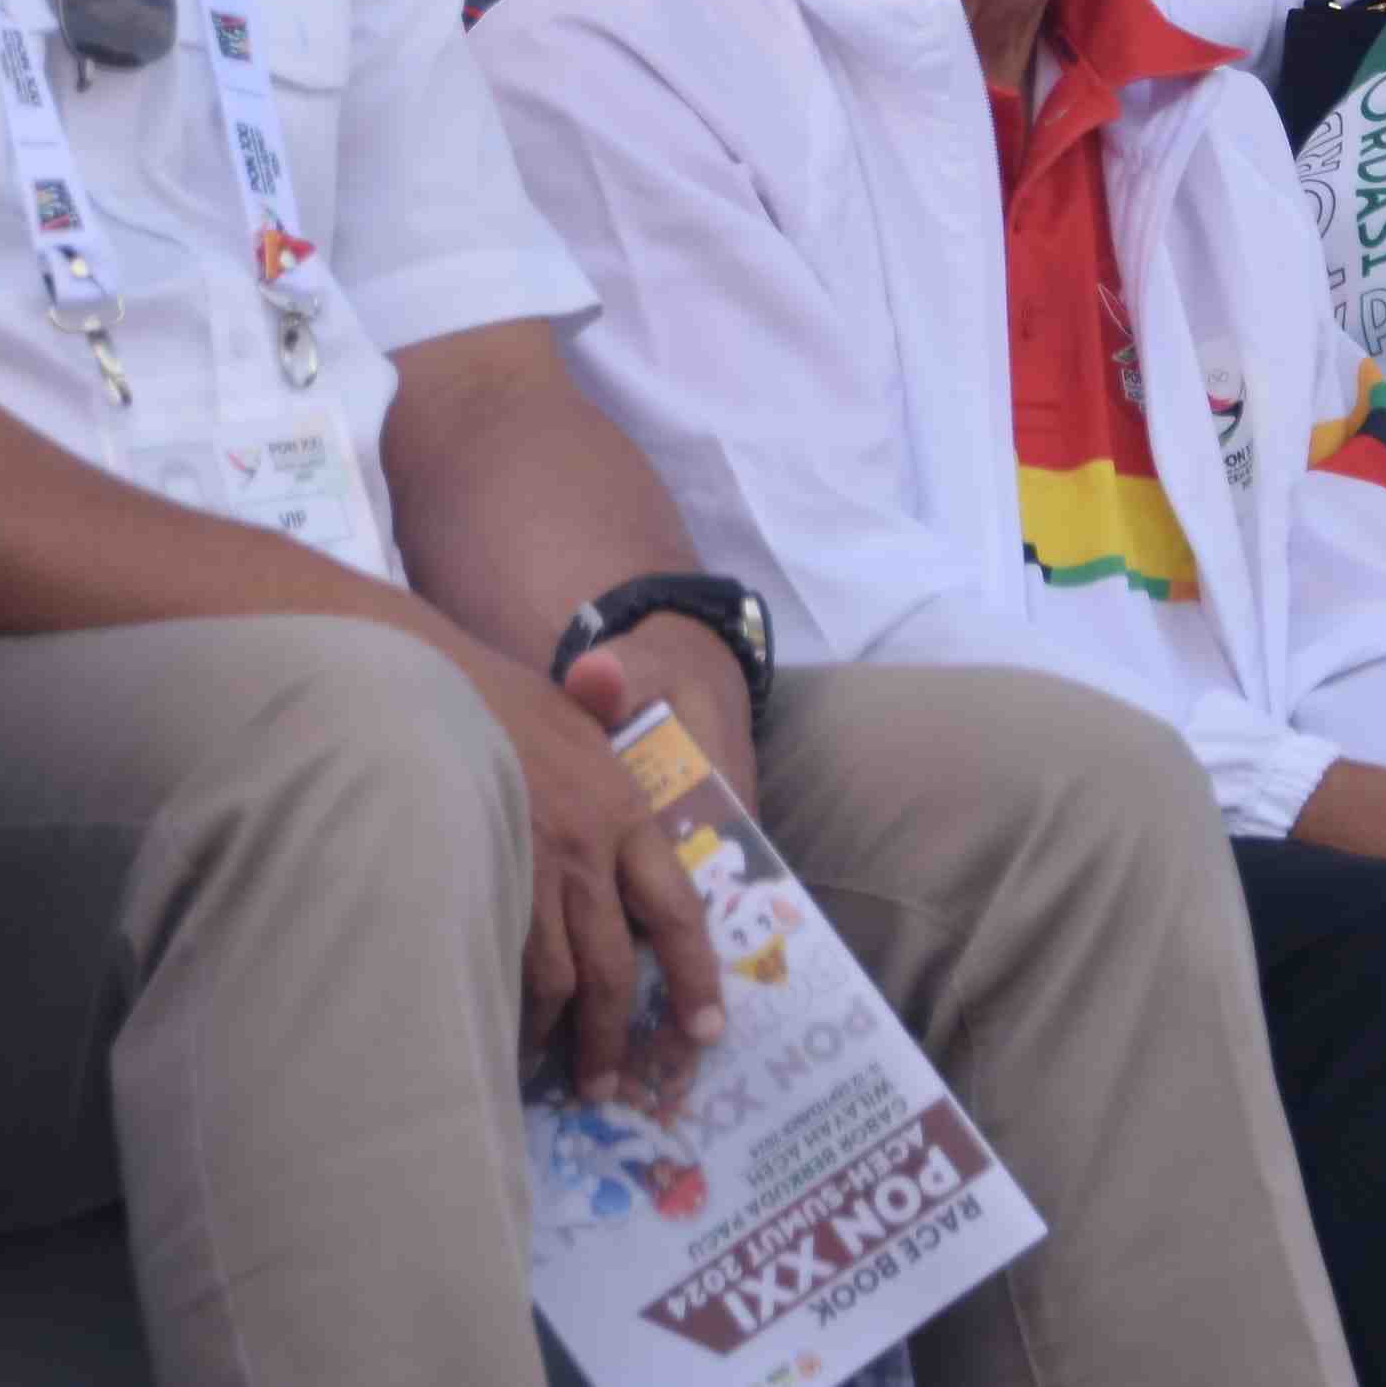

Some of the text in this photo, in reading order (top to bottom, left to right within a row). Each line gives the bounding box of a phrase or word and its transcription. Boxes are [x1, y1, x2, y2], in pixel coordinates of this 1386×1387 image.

[662, 1253, 745, 1323] 2024
[718, 1142, 963, 1335] PON XXI
[808, 1193, 985, 1327] RACE BOOK
